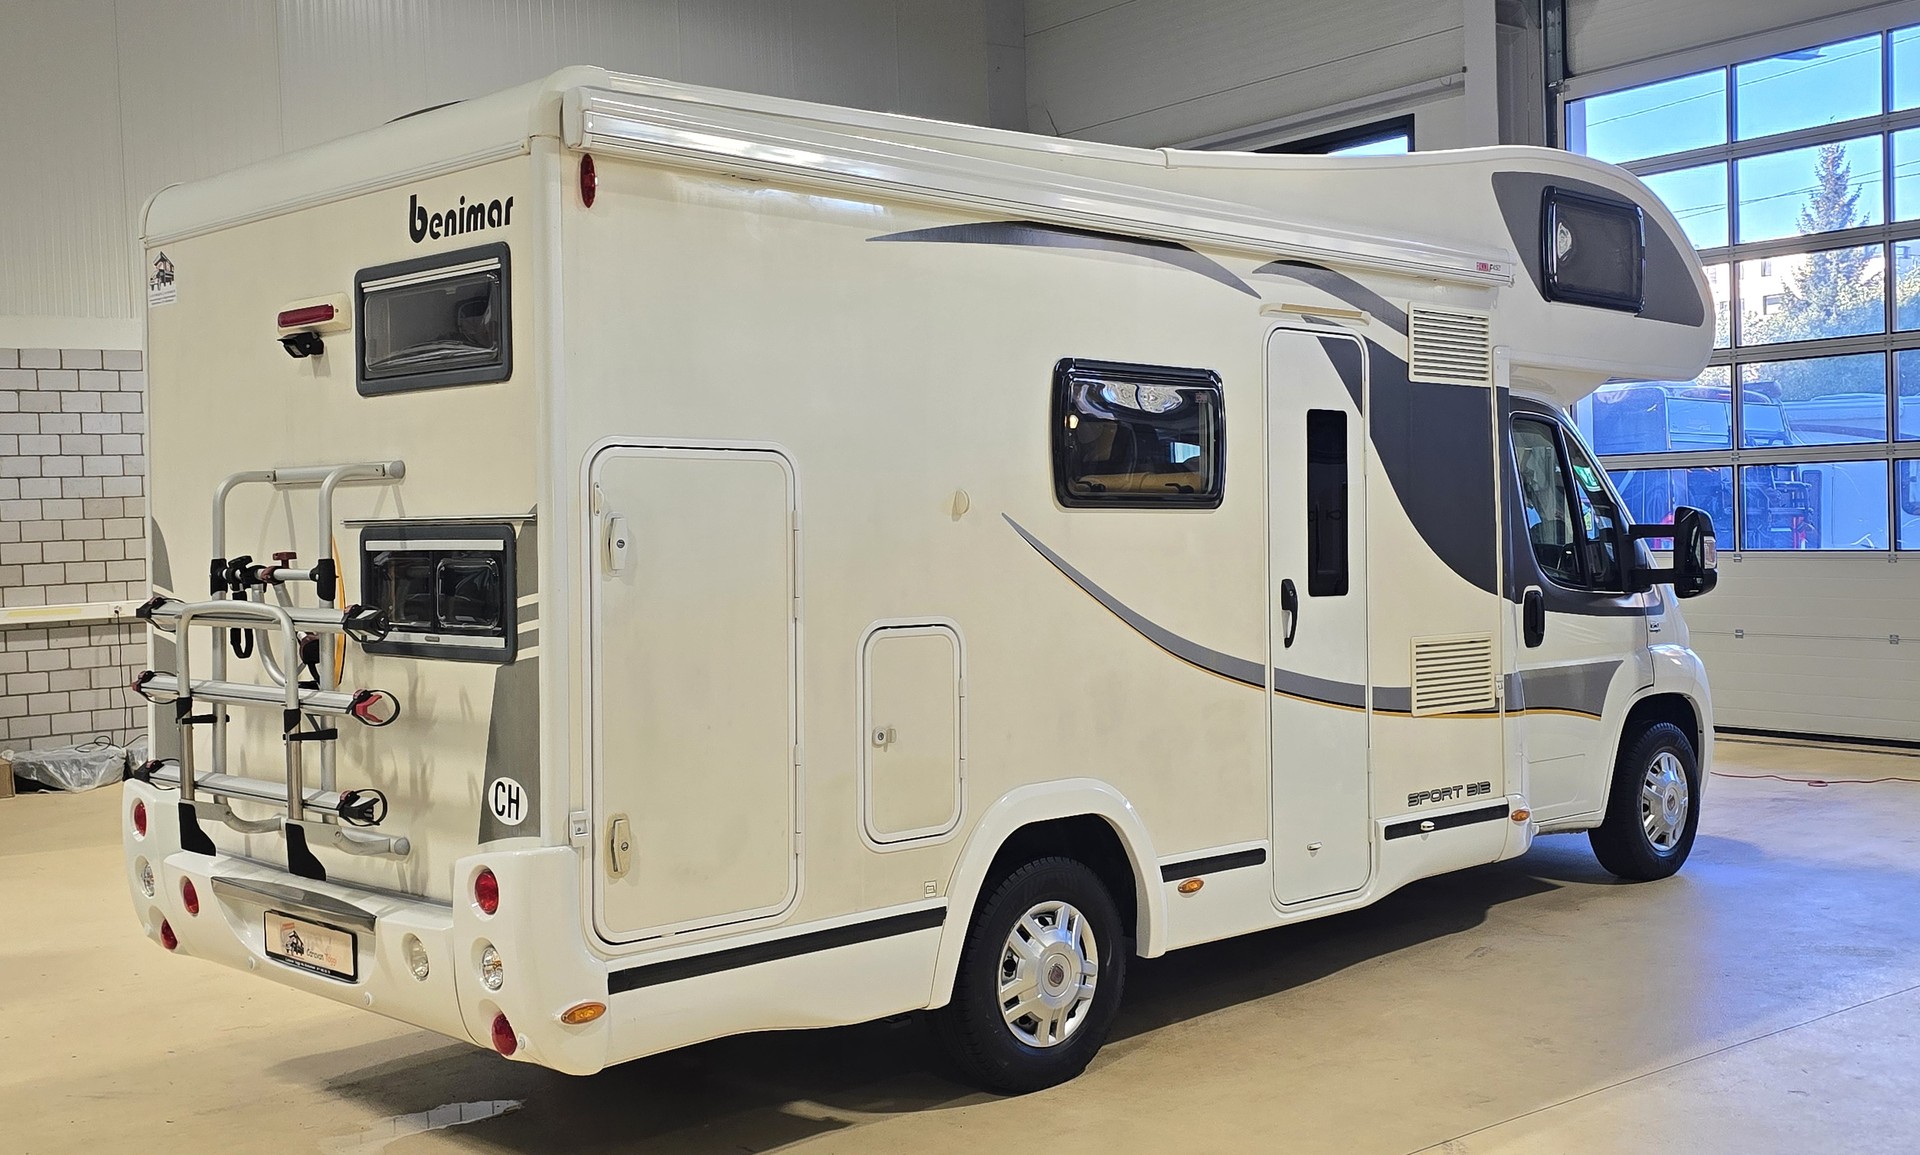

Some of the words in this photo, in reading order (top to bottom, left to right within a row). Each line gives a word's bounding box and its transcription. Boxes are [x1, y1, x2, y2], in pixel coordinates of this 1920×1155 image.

[409, 194, 514, 244] benimar
[495, 781, 520, 821] CH
[1407, 784, 1464, 808] SPORT
